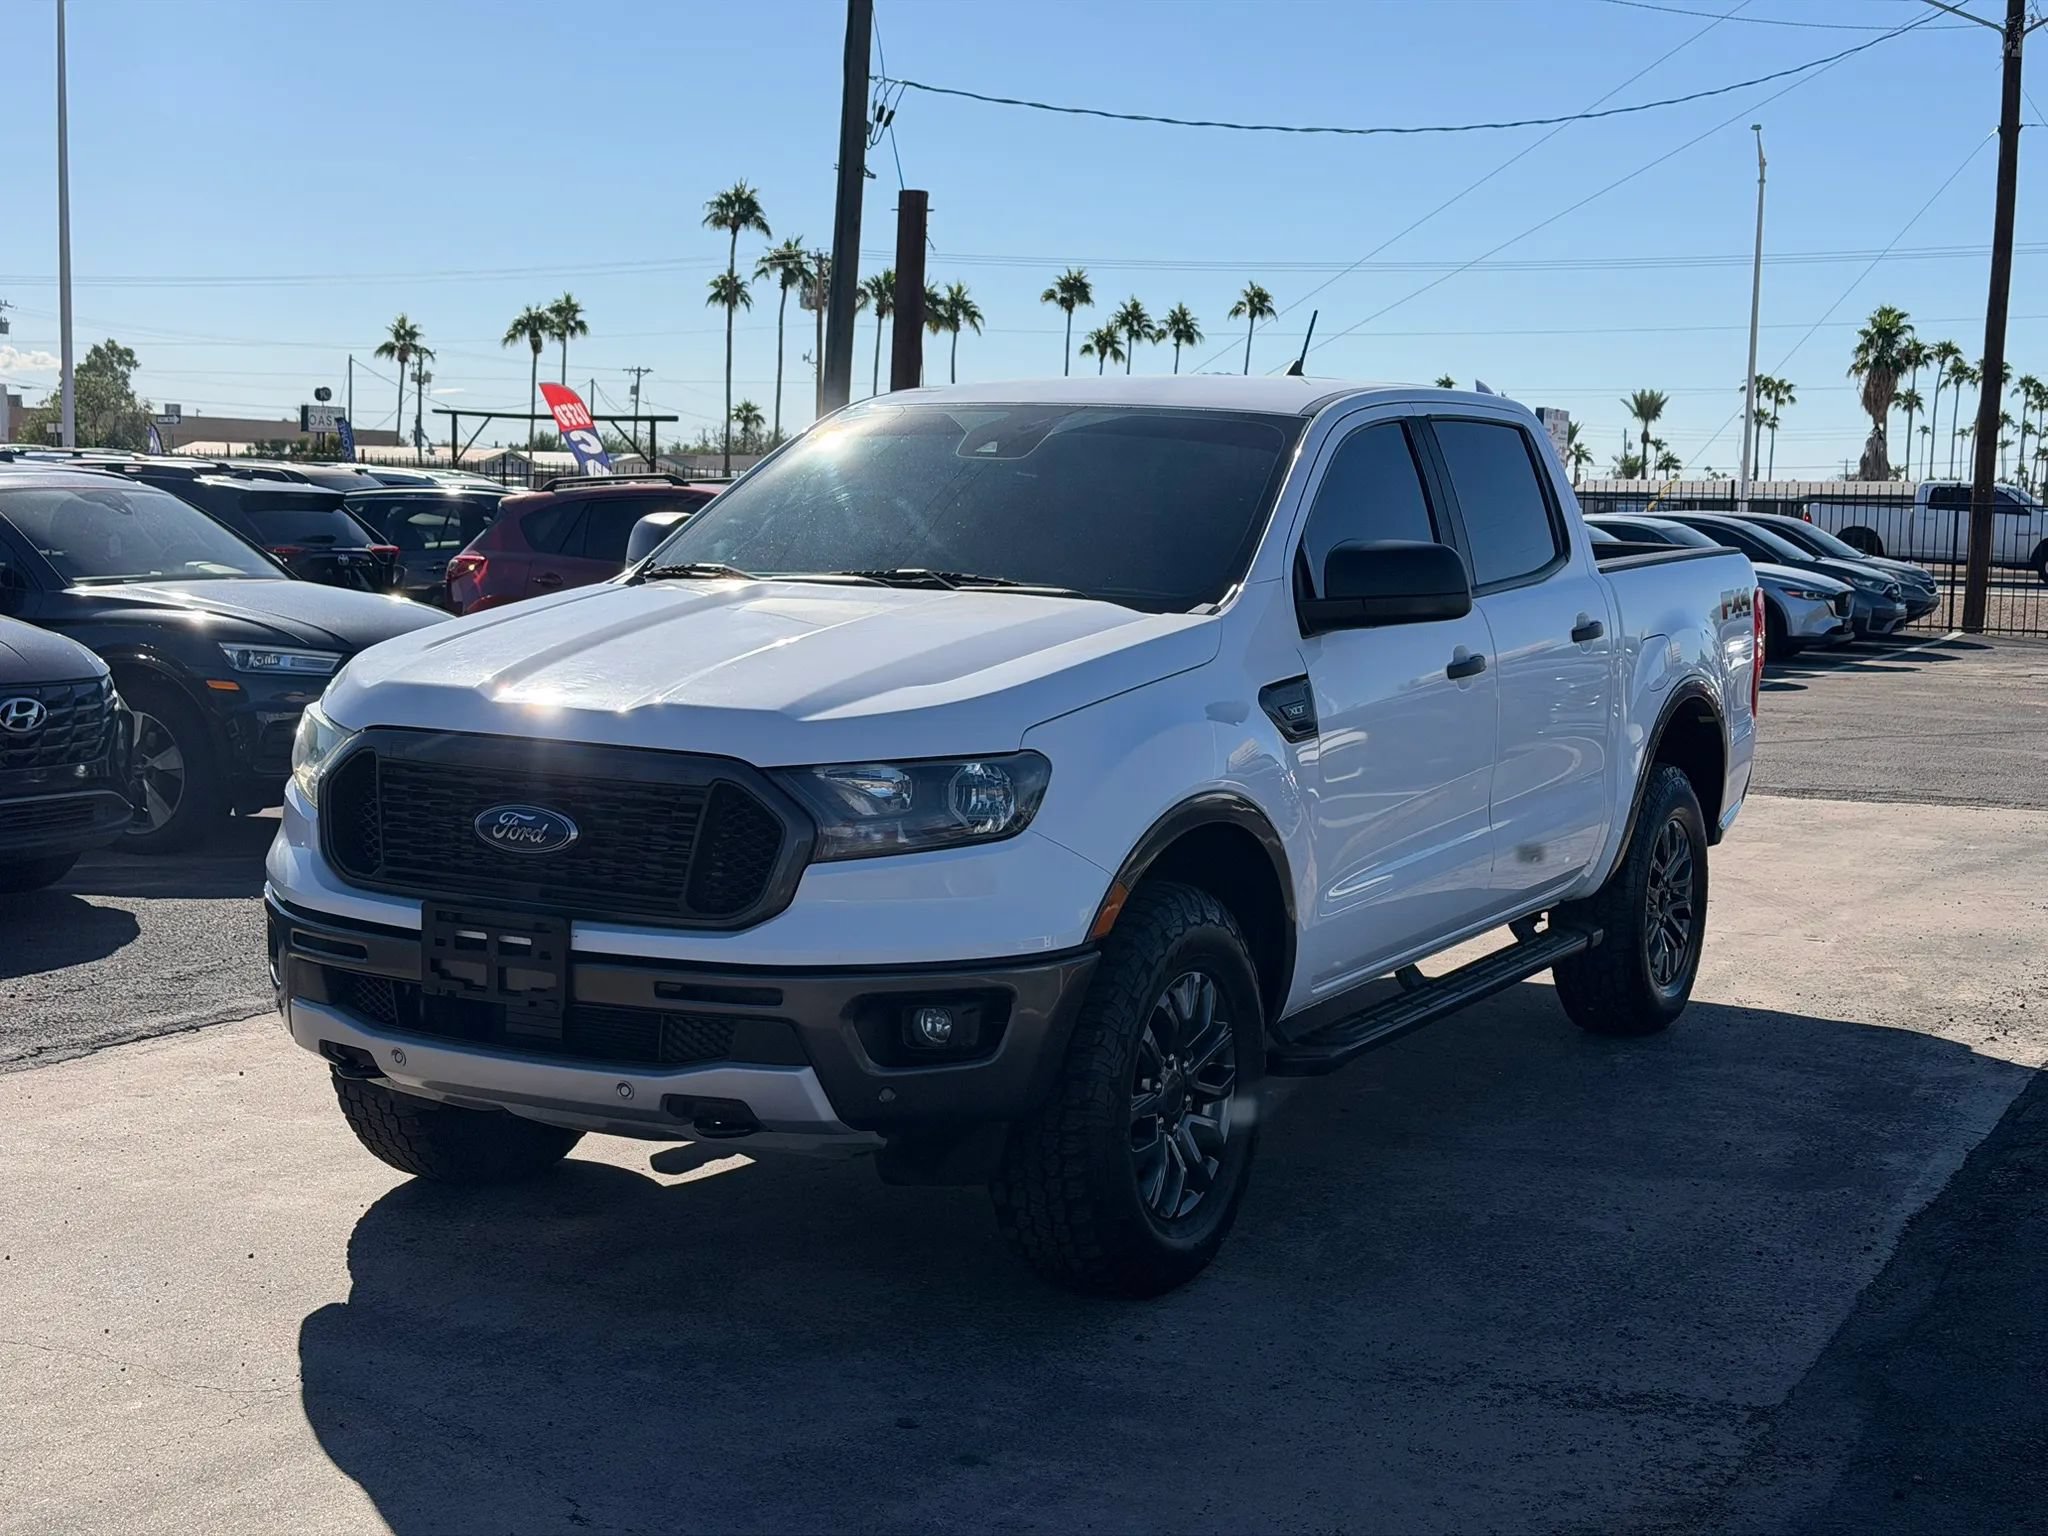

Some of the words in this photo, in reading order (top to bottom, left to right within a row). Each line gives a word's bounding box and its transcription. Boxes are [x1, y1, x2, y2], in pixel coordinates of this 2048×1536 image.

[309, 414, 336, 426] OAS
[1720, 587, 1751, 620] FX4
[1288, 705, 1305, 716] XLT
[492, 811, 549, 843] Ford
